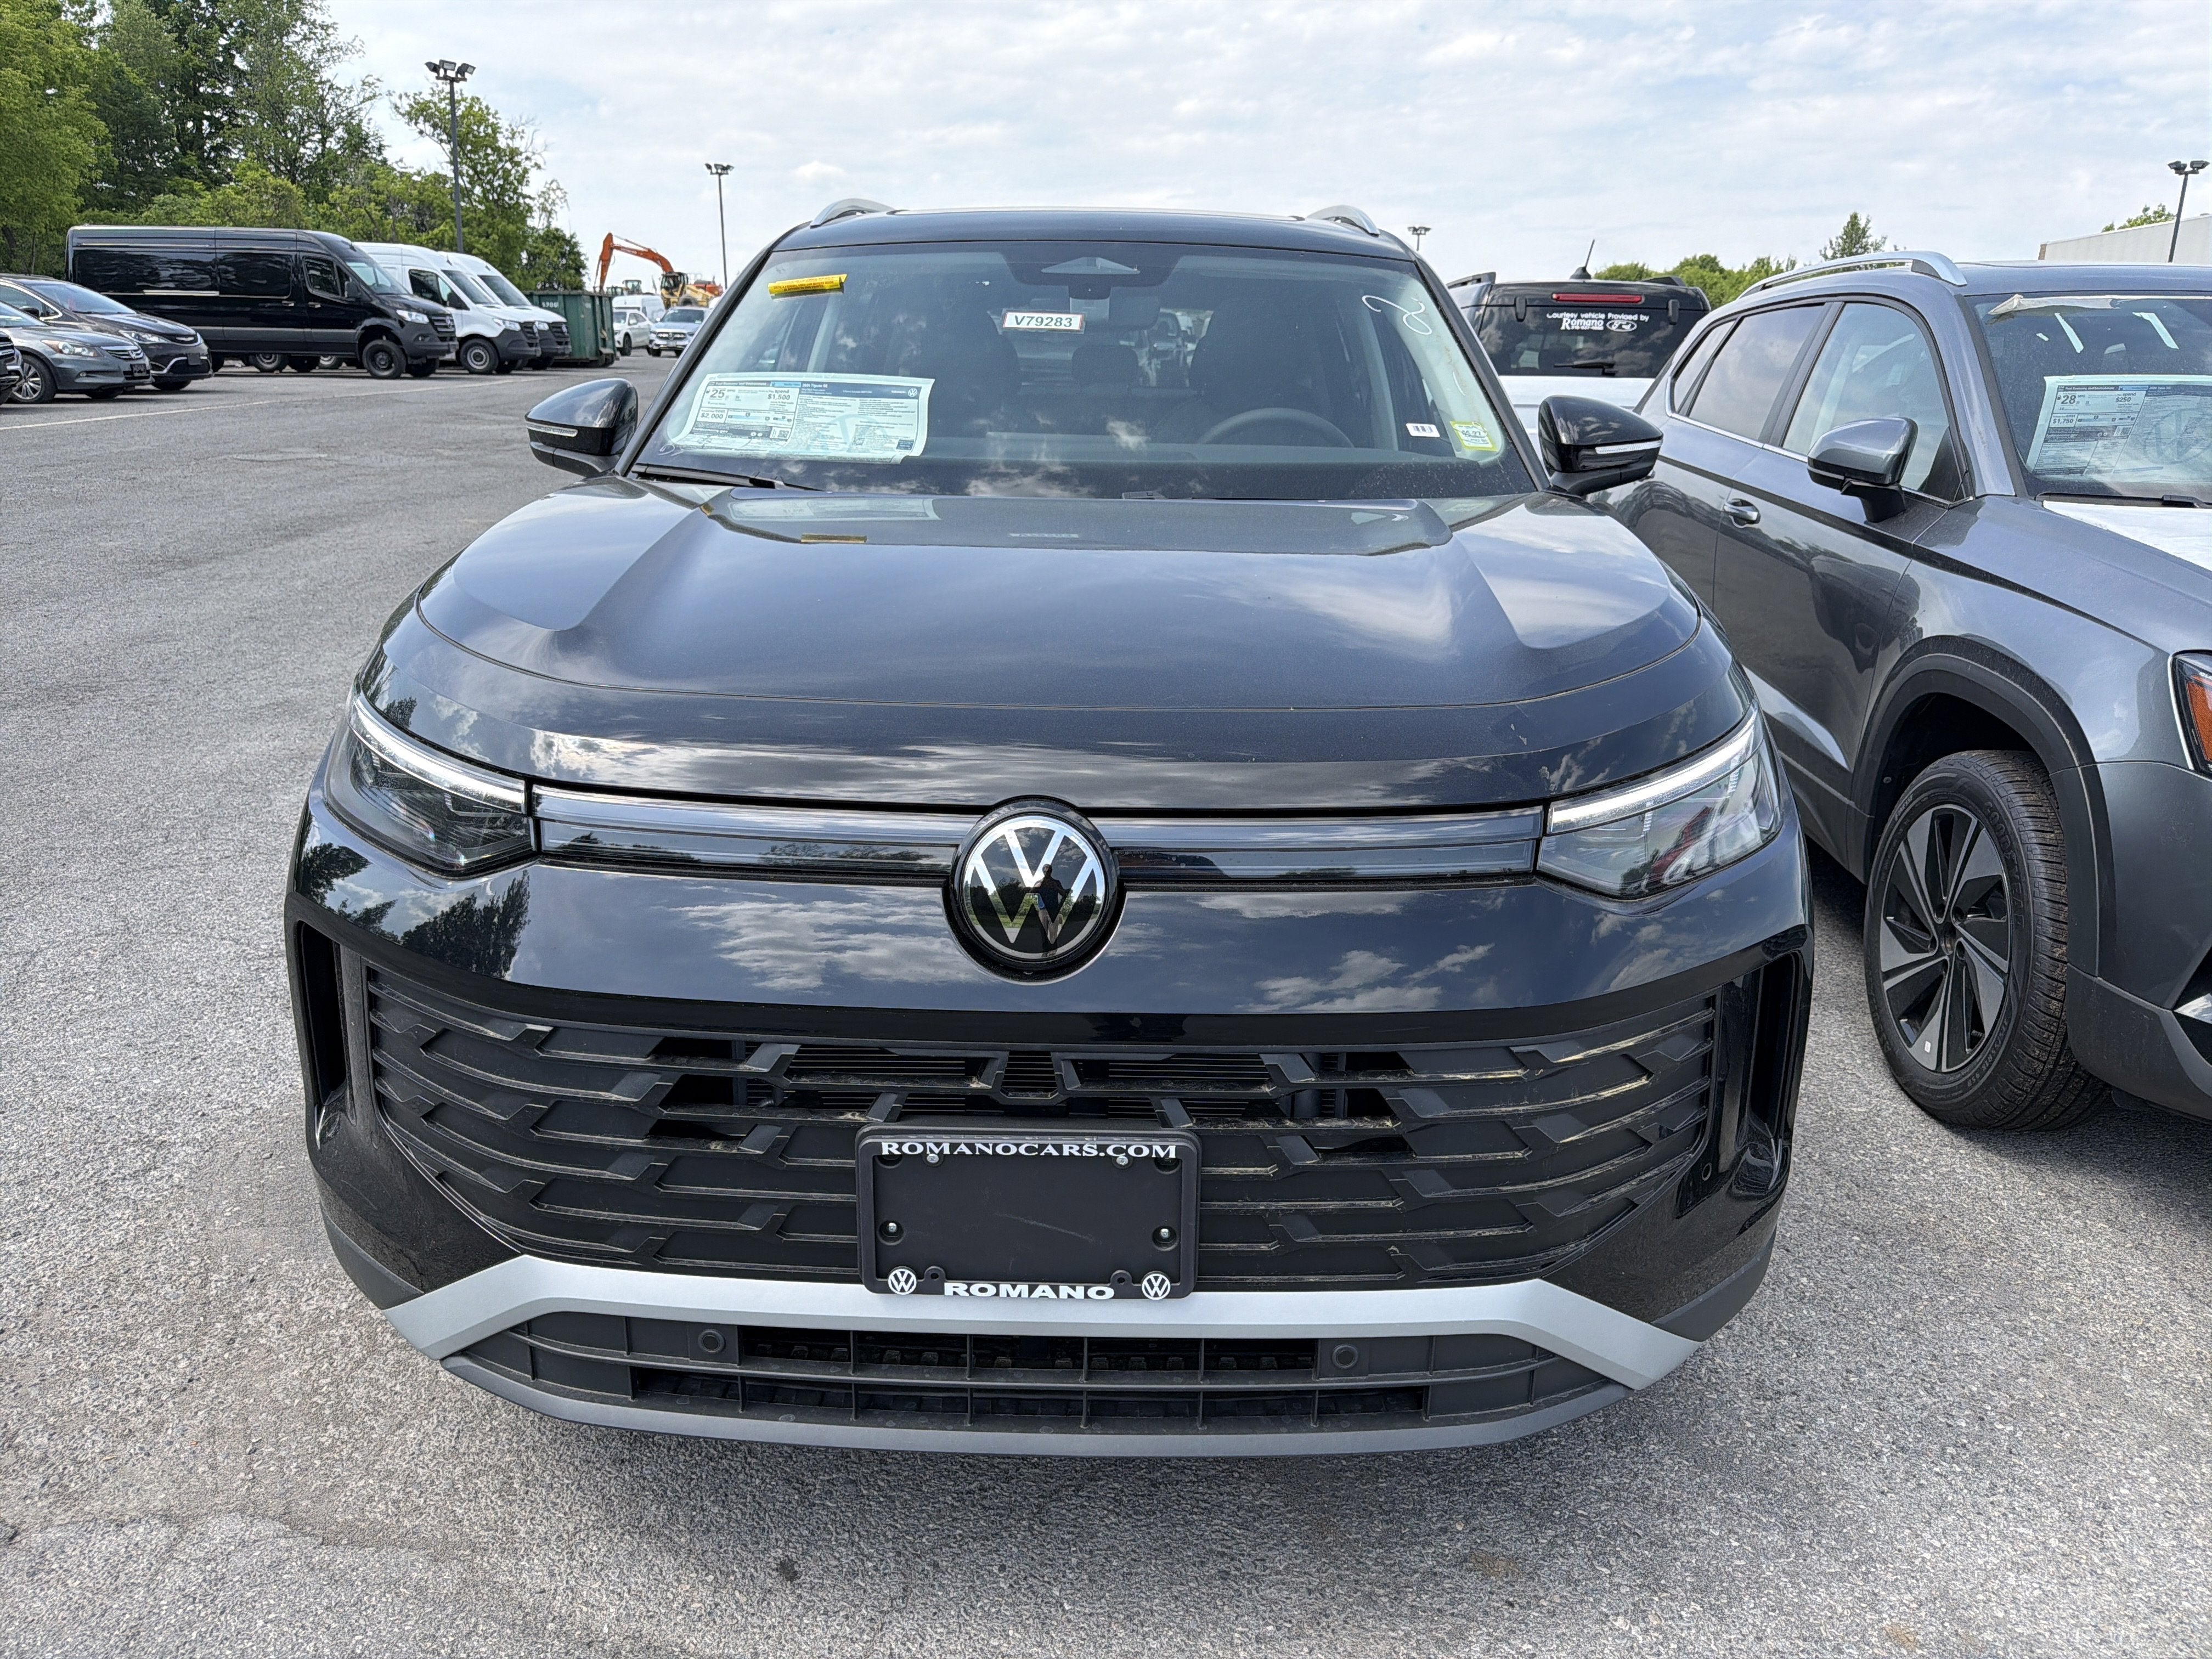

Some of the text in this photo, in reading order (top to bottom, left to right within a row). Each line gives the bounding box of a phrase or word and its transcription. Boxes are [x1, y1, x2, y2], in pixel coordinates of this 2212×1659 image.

[1014, 315, 1073, 328] V79283
[1560, 318, 1604, 330] Romano
[1639, 314, 1650, 322] by
[709, 388, 726, 398] 25
[2061, 394, 2076, 404] 28
[881, 1141, 1177, 1159] ROMANOCARS.COM
[944, 1282, 1115, 1300] ROMANO
